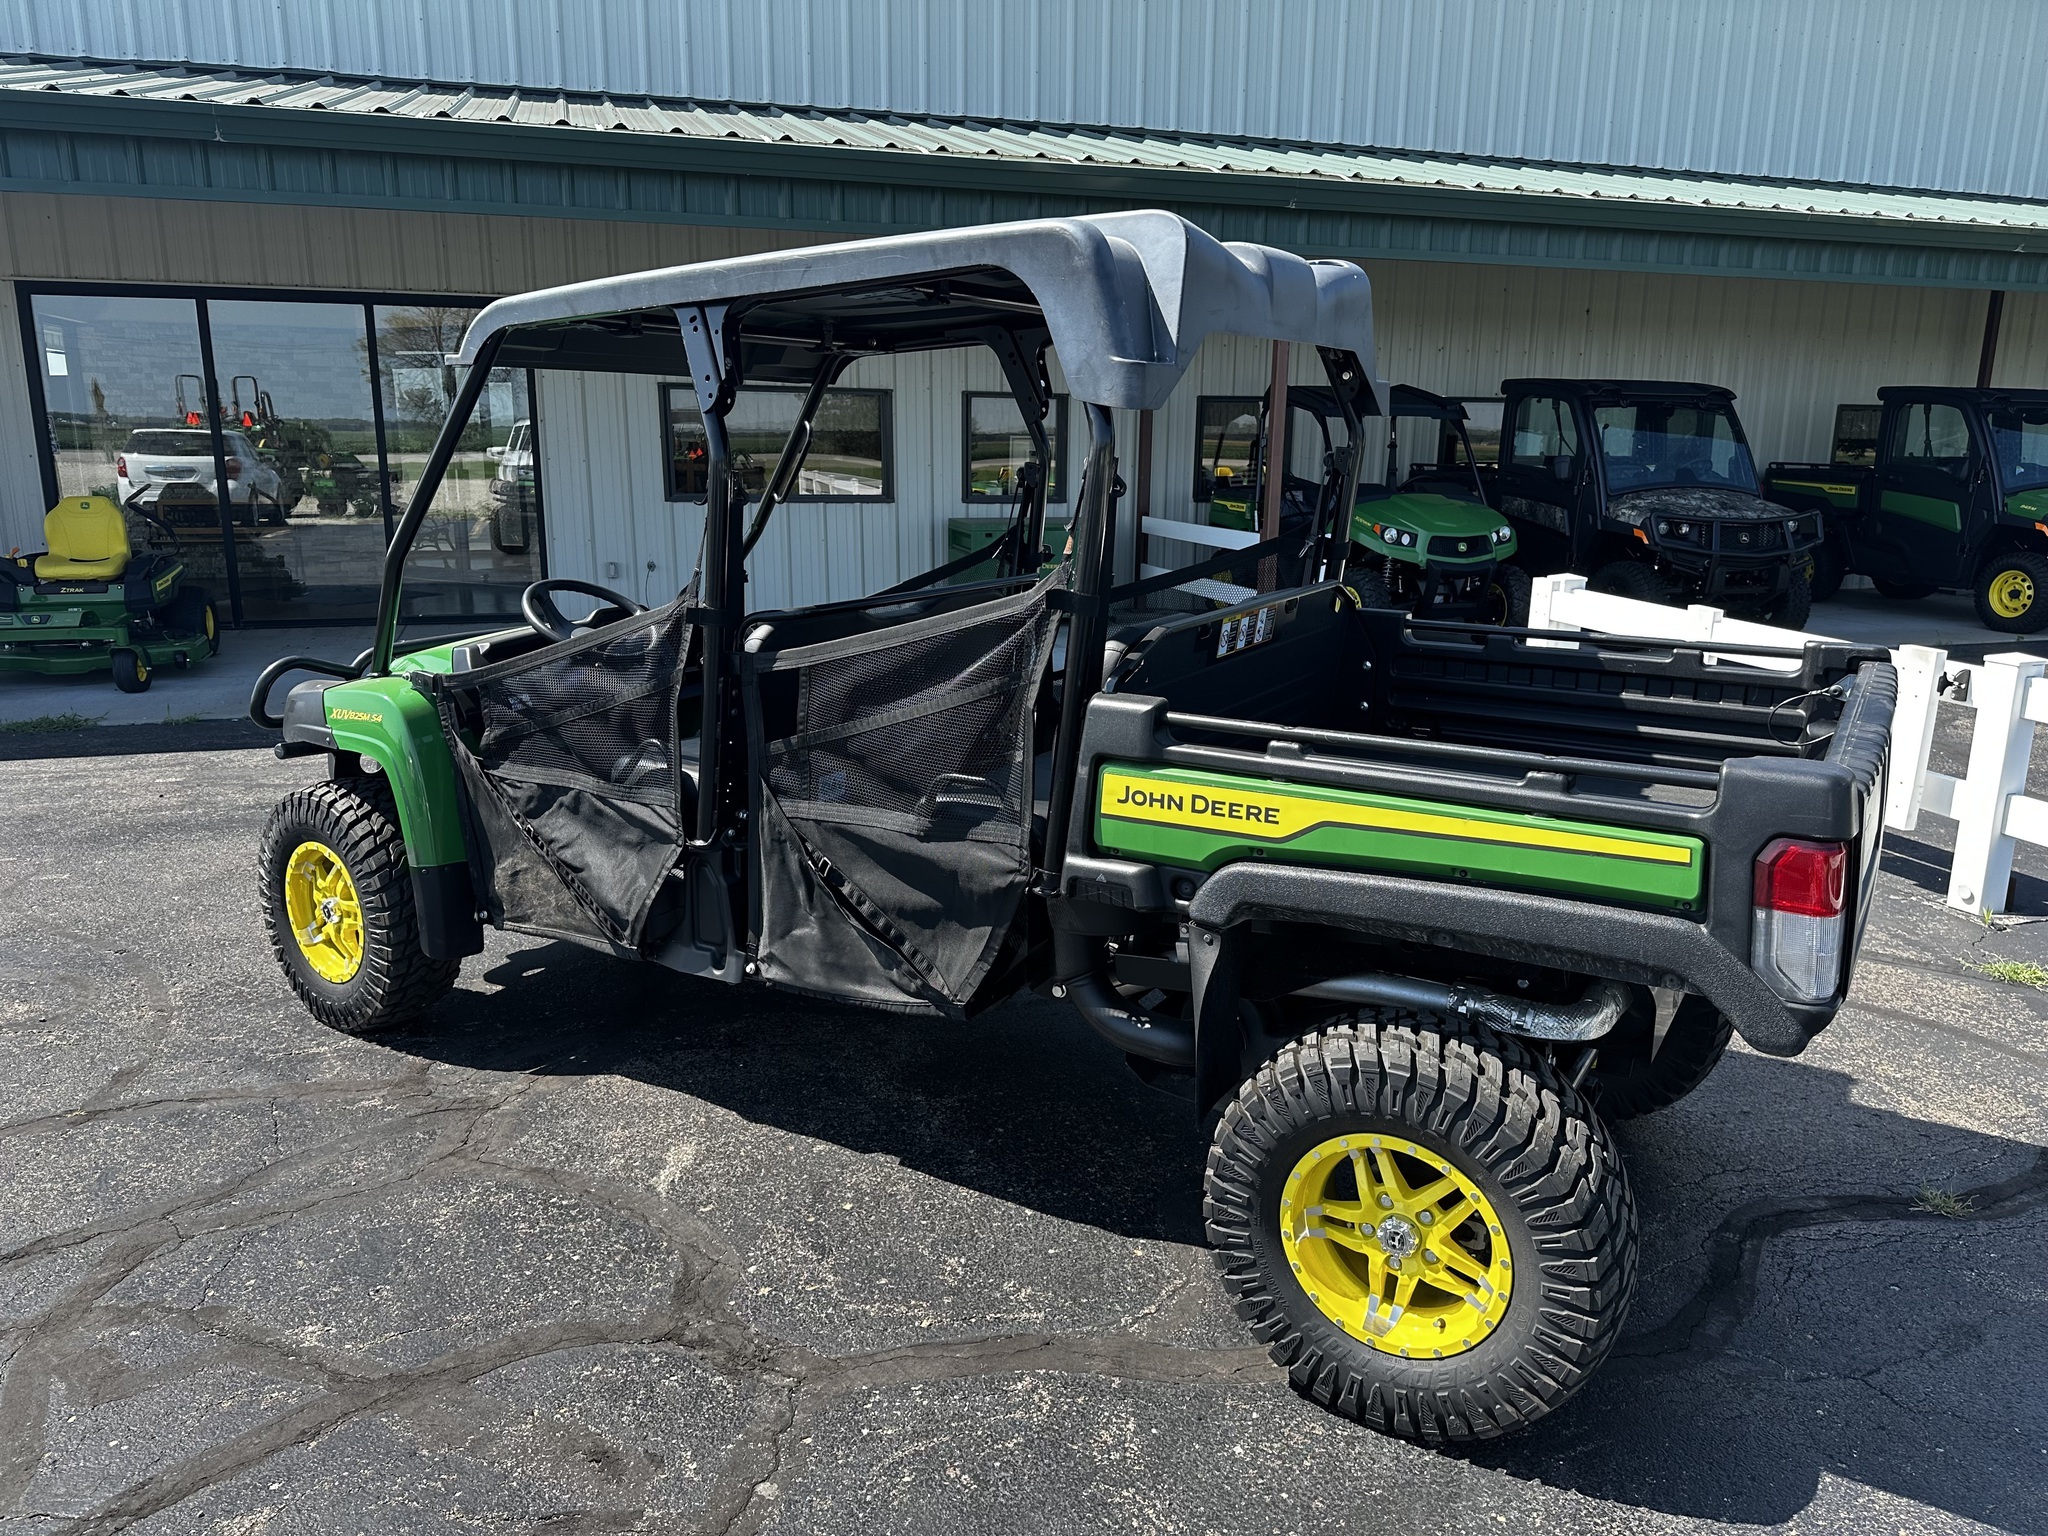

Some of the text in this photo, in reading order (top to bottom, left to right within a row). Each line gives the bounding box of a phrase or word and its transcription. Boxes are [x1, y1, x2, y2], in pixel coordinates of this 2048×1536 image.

[329, 708, 383, 722] XUV825M S4
[1117, 785, 1280, 825] JOHN DEERE
